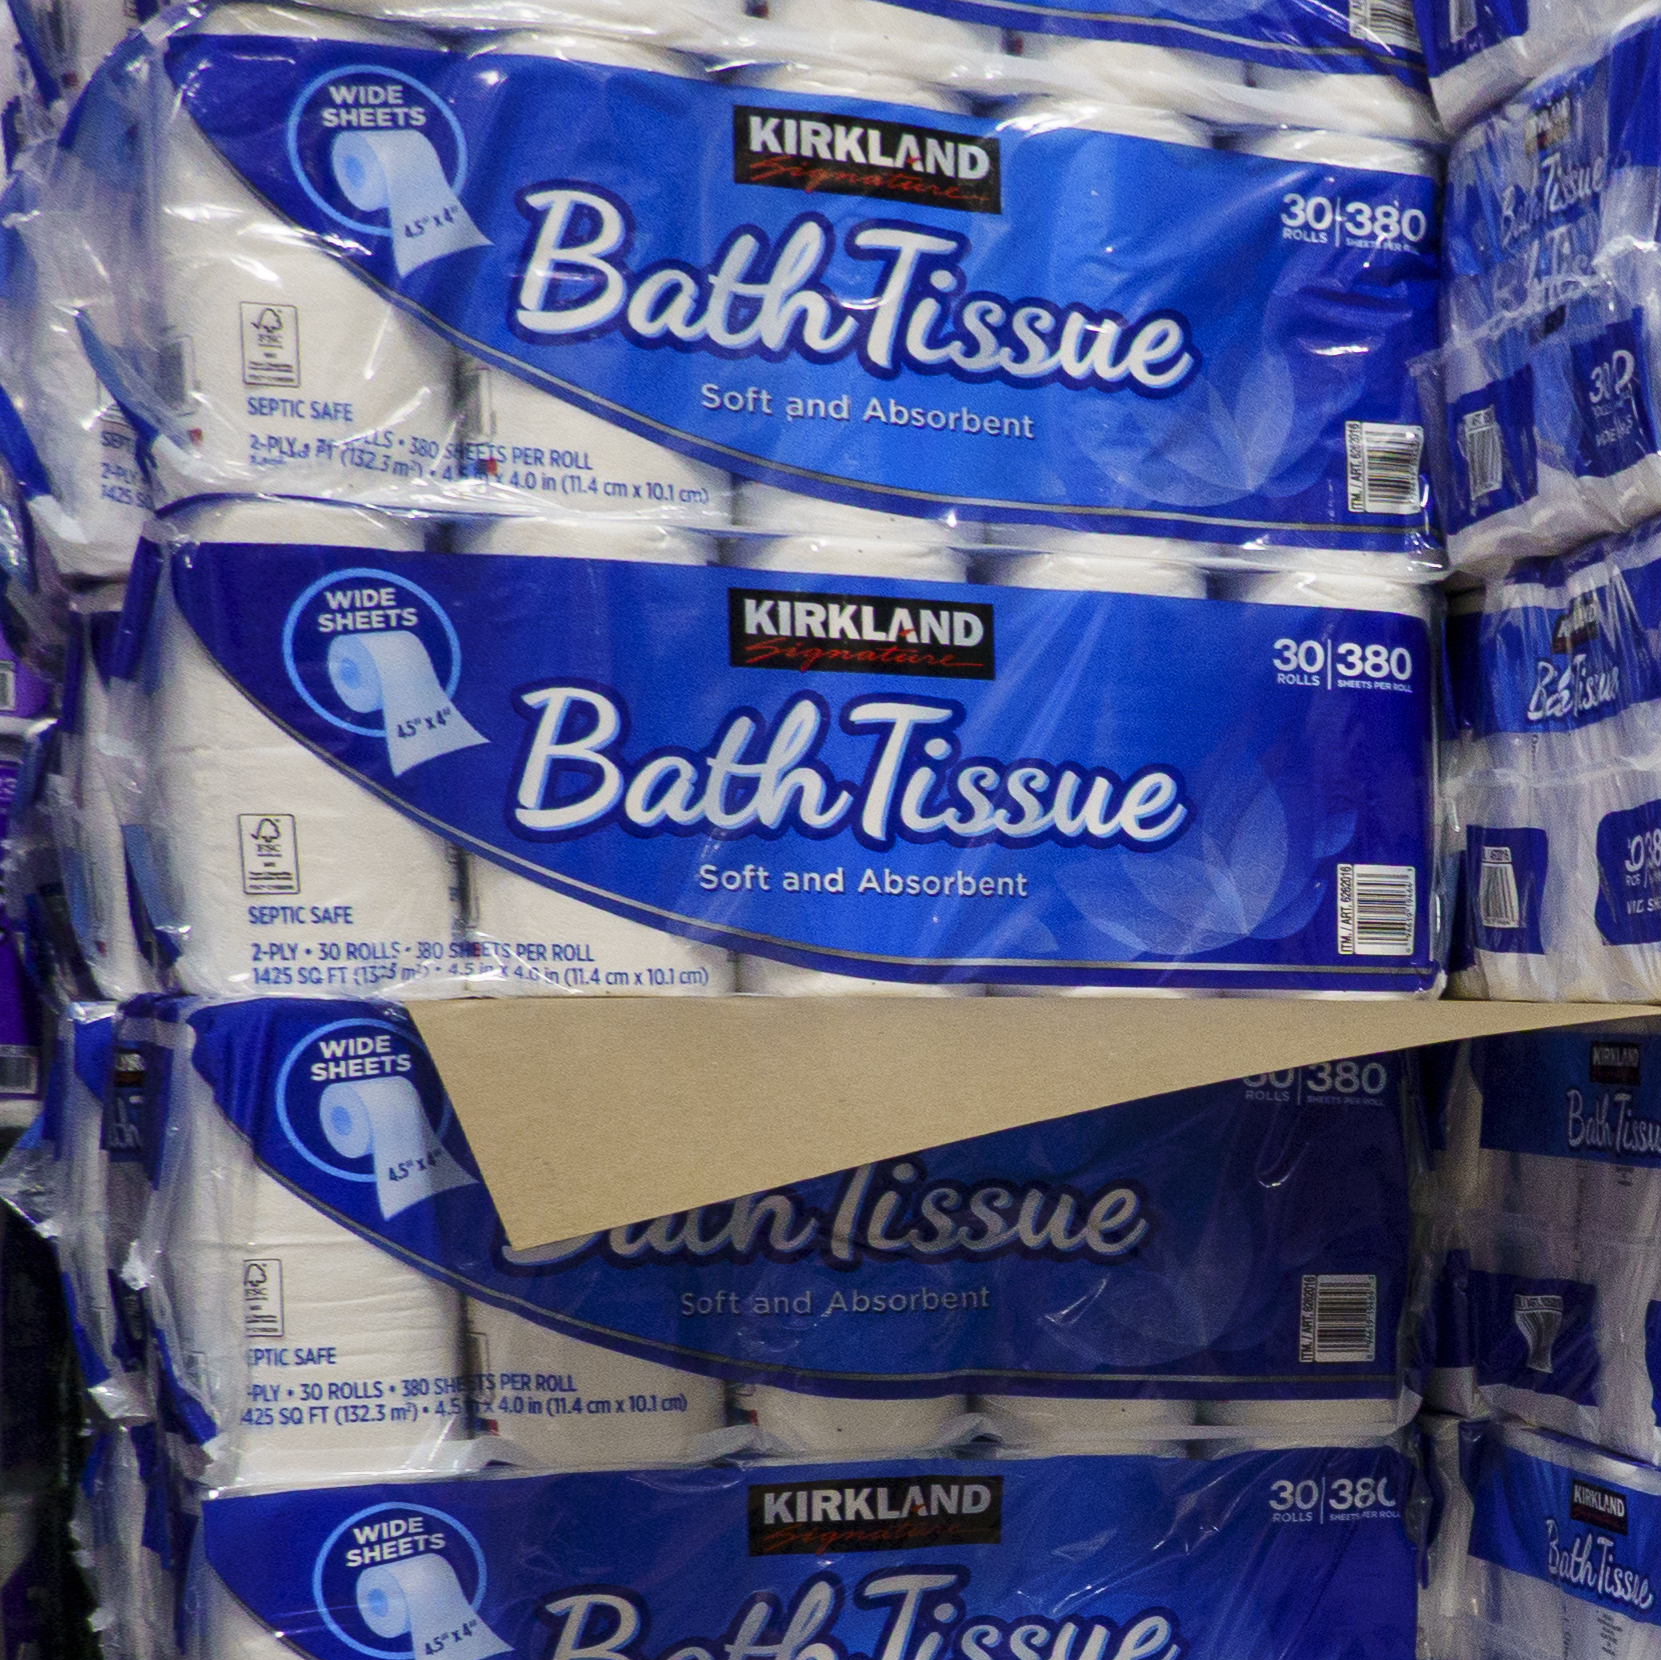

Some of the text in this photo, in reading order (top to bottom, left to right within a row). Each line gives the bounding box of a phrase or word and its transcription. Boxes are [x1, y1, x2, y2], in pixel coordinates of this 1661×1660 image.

[329, 85, 405, 105] WIDE
[322, 107, 426, 127] SHEETS
[749, 116, 991, 180] KIRKLAND
[1280, 194, 1427, 241] 30 380
[516, 189, 1194, 386] Bath Tissue
[702, 384, 1034, 441] Soft and Absorbent
[325, 588, 396, 608] WIDE
[318, 609, 418, 632] SHEETS
[744, 598, 984, 648] KIRKLAND
[1273, 639, 1412, 680] 30 380
[1277, 673, 1320, 686] ROLLS
[515, 687, 1186, 841] Bath Tissue
[699, 864, 1028, 899] Soft and Absorbent
[319, 1034, 391, 1059] WIDE
[310, 1054, 412, 1082] SHEETS
[1307, 1059, 1387, 1094] 380
[681, 1285, 990, 1317] Soft and Absorbent
[764, 1484, 992, 1526] KIRKLAND
